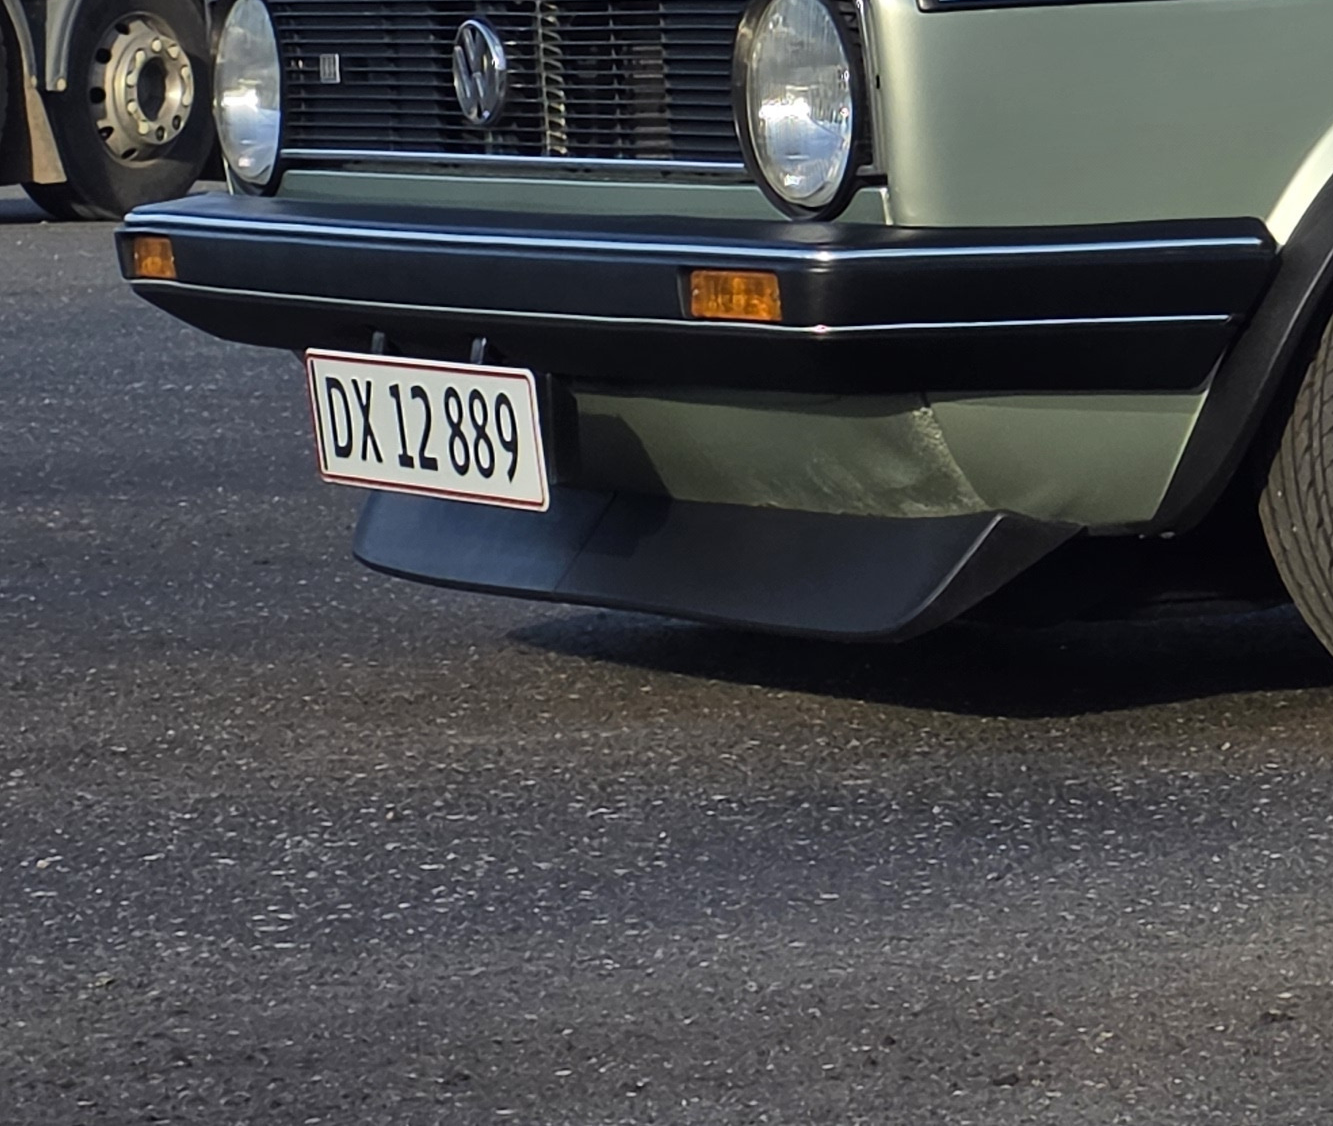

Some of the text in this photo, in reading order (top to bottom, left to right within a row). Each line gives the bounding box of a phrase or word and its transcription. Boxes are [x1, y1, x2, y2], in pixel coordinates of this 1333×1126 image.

[325, 376, 519, 484] DX 12 889
